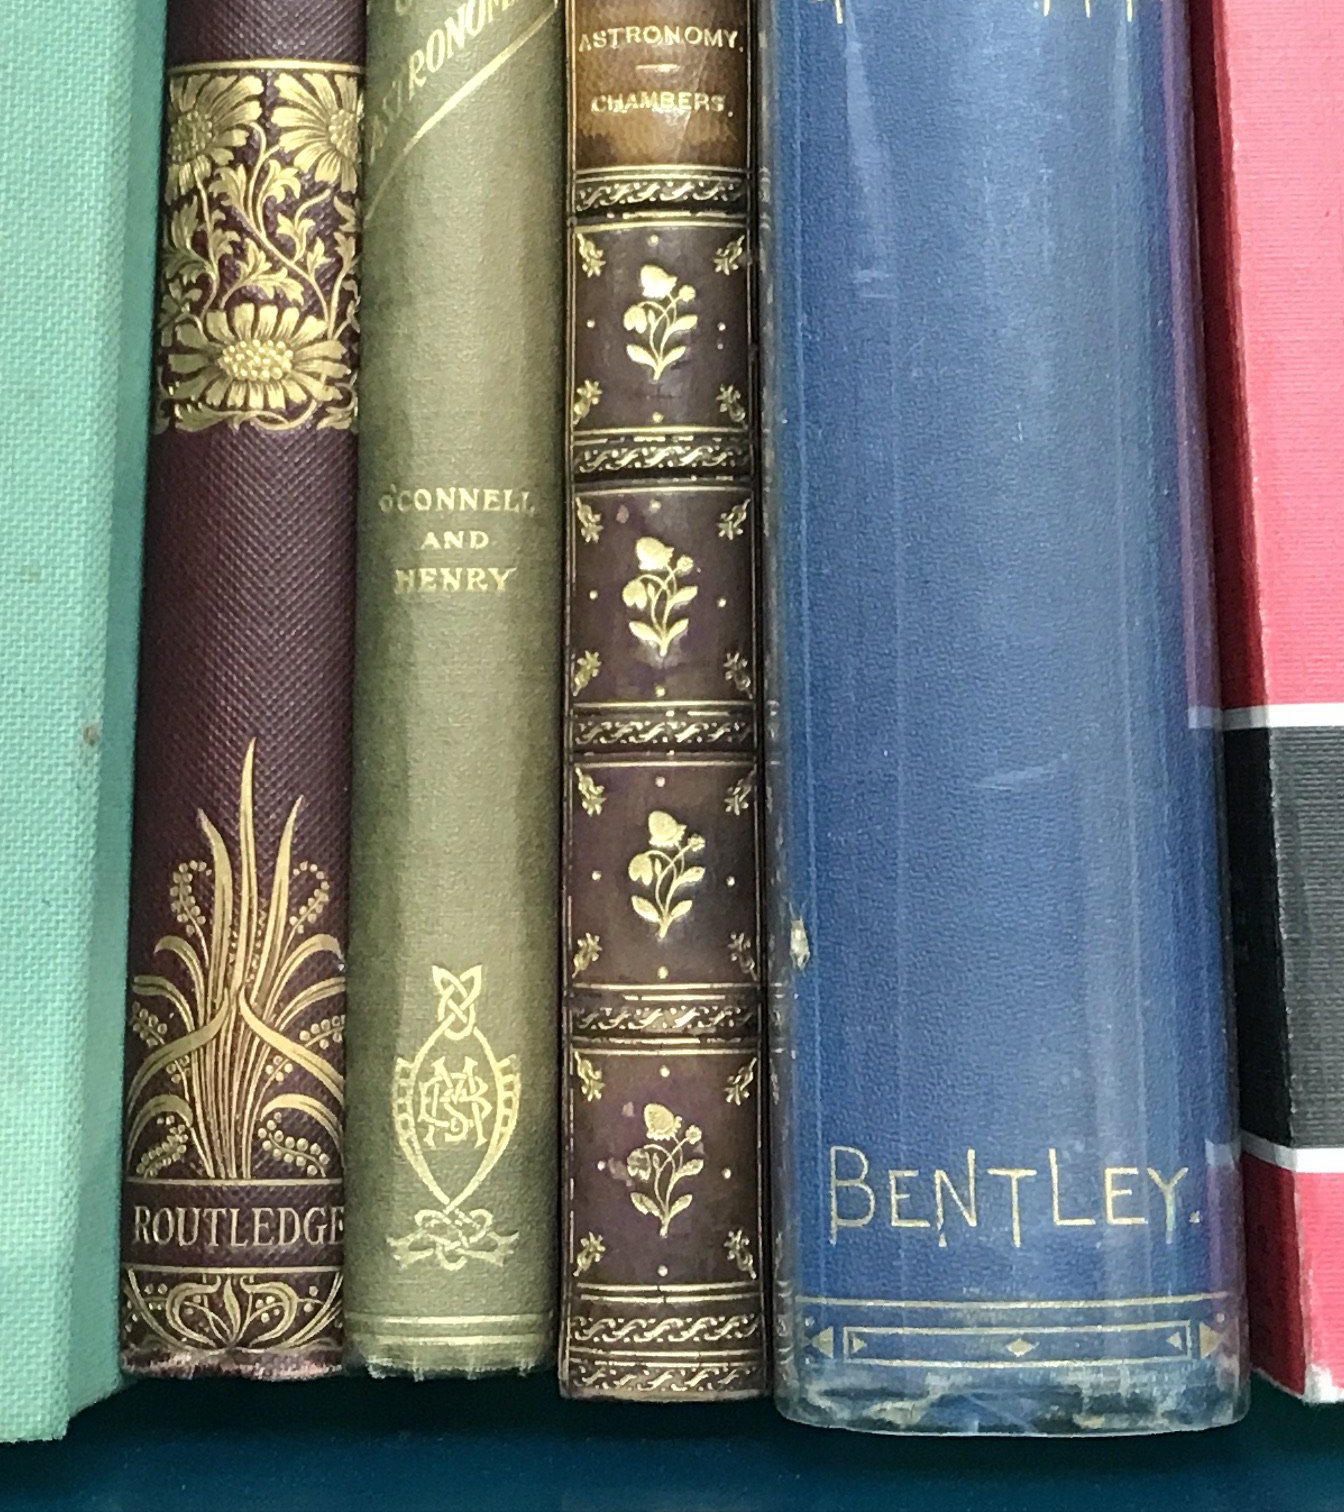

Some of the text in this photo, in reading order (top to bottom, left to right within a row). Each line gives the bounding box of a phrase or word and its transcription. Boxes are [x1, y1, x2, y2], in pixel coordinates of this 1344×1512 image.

[578, 24, 744, 53] ASTRONOMY.
[590, 90, 734, 118] CHAMBERS.
[419, 530, 490, 551] AND
[393, 567, 519, 594] HENRY
[828, 1144, 1202, 1248] BENTLEY.
[131, 1205, 346, 1248] ROUTLEDGE
